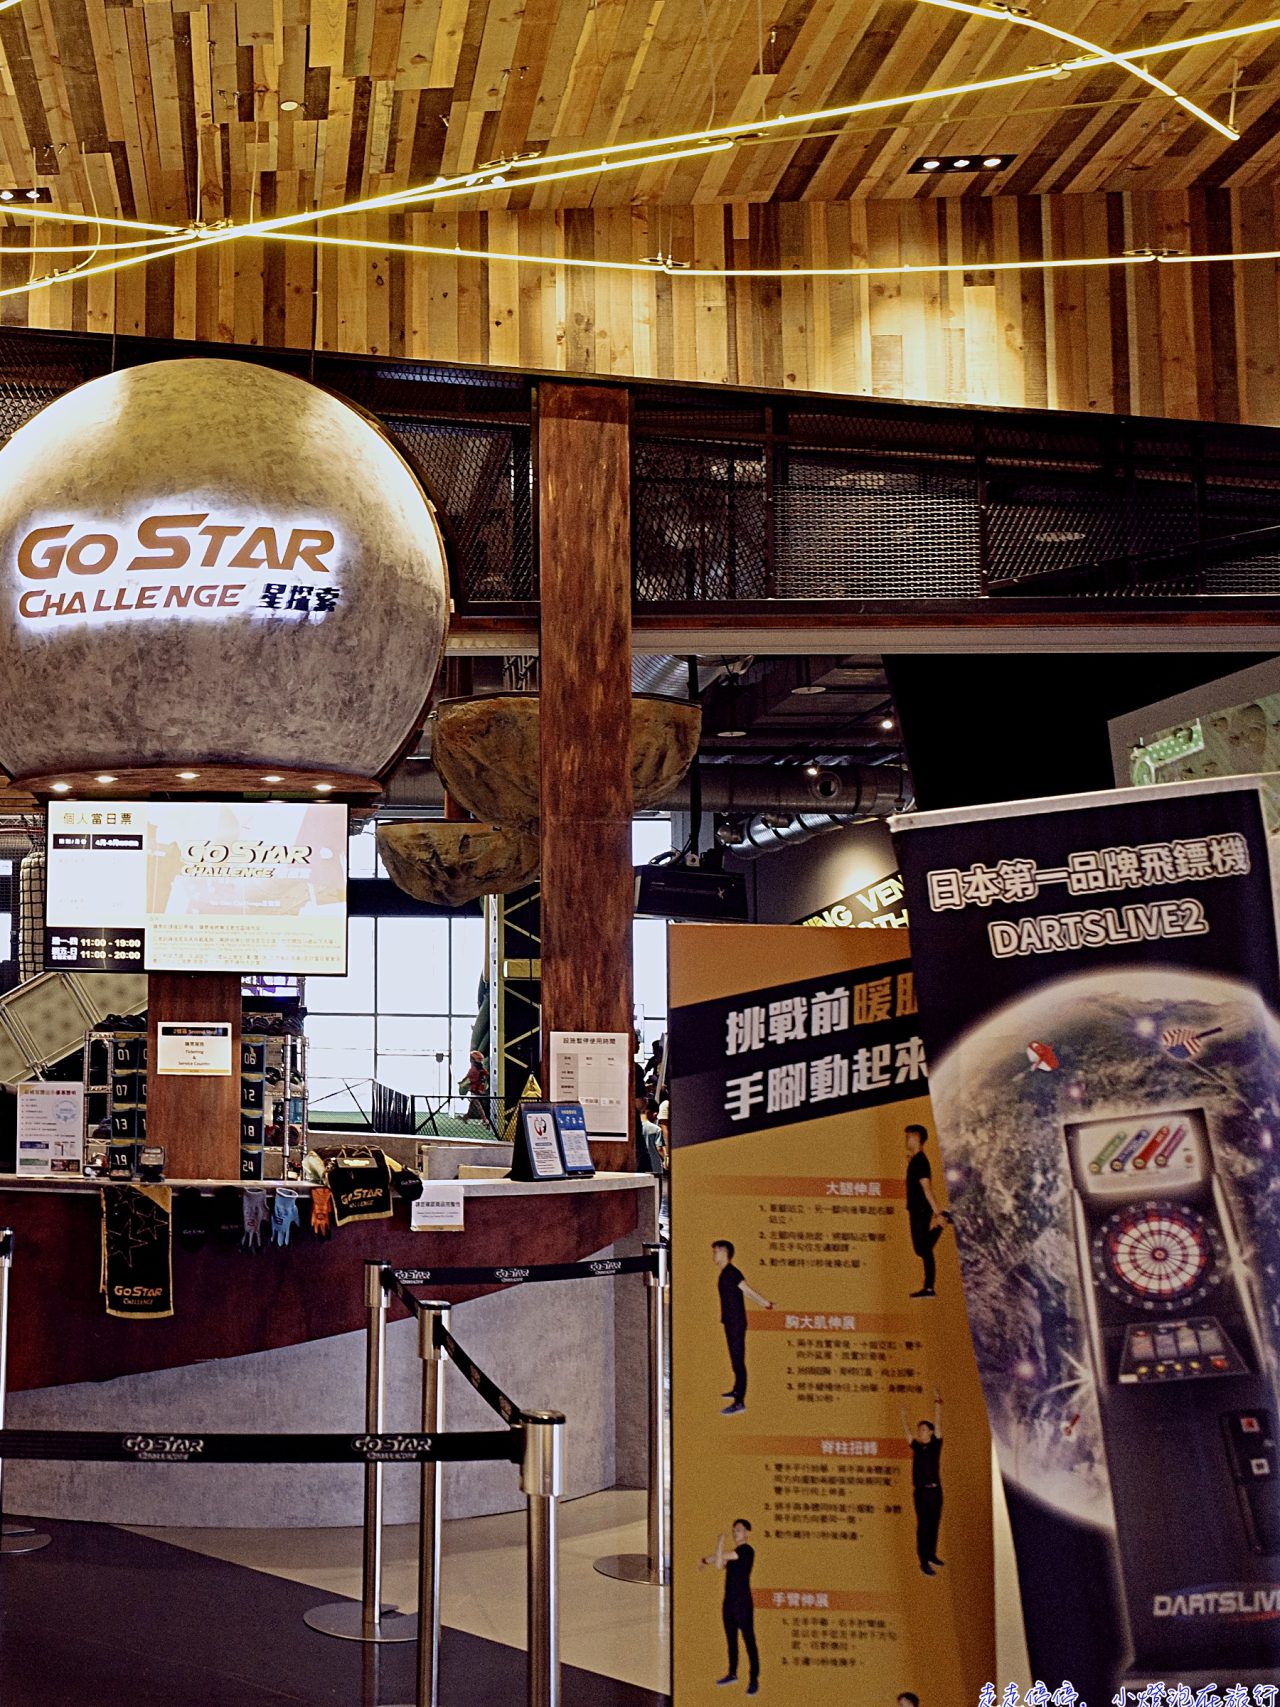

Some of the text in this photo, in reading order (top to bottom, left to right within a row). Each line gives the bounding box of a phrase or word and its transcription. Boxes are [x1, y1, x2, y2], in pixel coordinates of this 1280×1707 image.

[19, 583, 340, 618] CHALLENGE 星探索
[63, 812, 133, 825] 個人當日票
[928, 833, 1249, 912] 日本第一品牌飛鏢機
[988, 898, 1209, 958] DARTSLIVE2
[80, 938, 107, 947] 11:00
[114, 939, 141, 948] 19:00
[80, 951, 107, 959] 11:00
[114, 952, 141, 960] 20:00
[117, 1049, 130, 1061] 01
[115, 1085, 128, 1097] 07
[243, 1089, 256, 1102] 12
[115, 1118, 128, 1130] 13
[243, 1125, 255, 1137] 18
[115, 1154, 127, 1166] 19
[242, 1160, 254, 1173] 24
[826, 1182, 881, 1196] 大腿伸展
[784, 1315, 855, 1330] 胸大肌伸展
